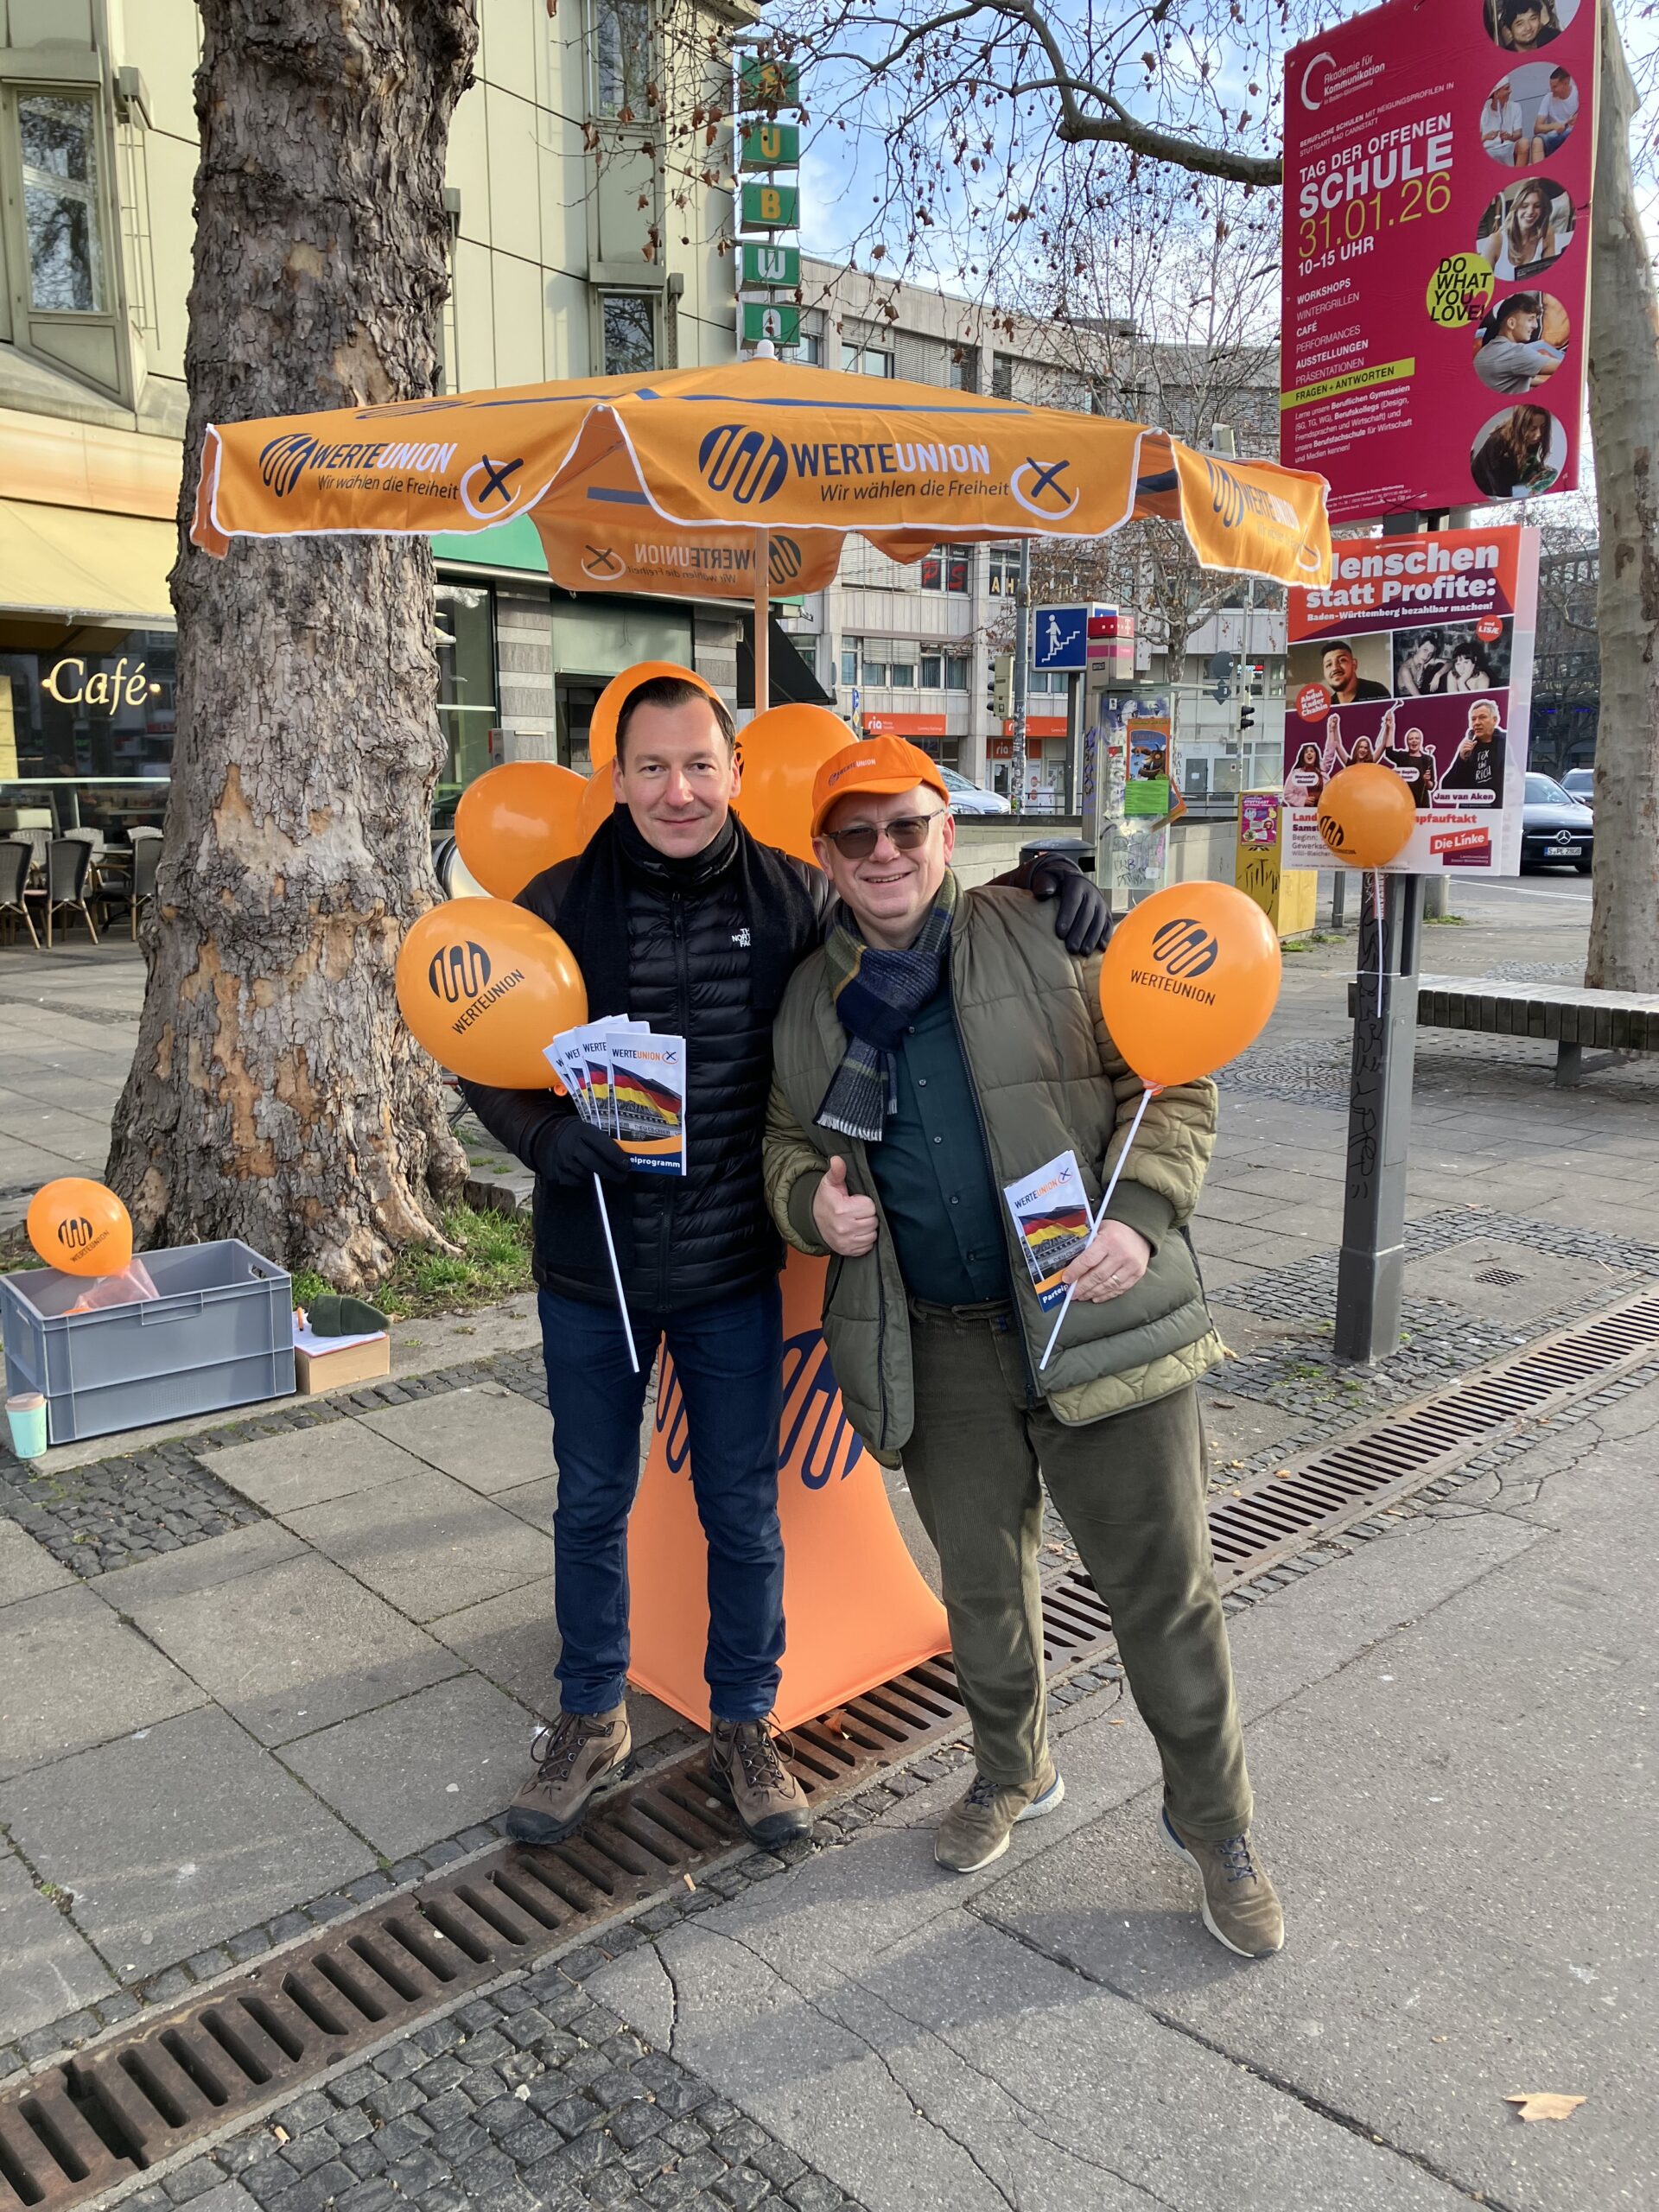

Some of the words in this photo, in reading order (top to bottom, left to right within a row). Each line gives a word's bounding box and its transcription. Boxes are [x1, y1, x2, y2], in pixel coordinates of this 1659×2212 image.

[1324, 60, 1360, 85] Akademie
[1362, 54, 1374, 67] für
[1324, 62, 1385, 97] Kommunikation
[1300, 127, 1334, 148] BERUFLICHE
[1336, 115, 1363, 131] SCHULEN
[1365, 109, 1376, 119] MIT
[1377, 86, 1444, 113] NEIGUNGSPROFILEN
[1446, 82, 1454, 91] IN
[1300, 138, 1331, 157] STUTTGART
[1332, 133, 1344, 143] BAD
[1344, 118, 1378, 137] CANNSTATT
[1300, 156, 1326, 183] TAG
[1332, 143, 1362, 168] DER
[1368, 112, 1452, 155] OFFENEN
[1300, 132, 1453, 219] SCHULE
[1300, 172, 1451, 259] 31.01.26
[1340, 236, 1375, 261] UHR
[1439, 257, 1467, 275] DO
[1297, 277, 1351, 305] WORKSHOPS
[1436, 272, 1492, 289] WHAT
[1296, 291, 1360, 321] WINTERGRILLEN
[1434, 289, 1474, 306] YOU
[1430, 304, 1485, 322] LOVE!
[1296, 321, 1318, 337] CAFÉ
[1296, 324, 1361, 353] PERFORMANCES
[1296, 340, 1369, 370] AUSSTELLUNGEN
[1296, 357, 1364, 385] PRÄSENTATIONEN
[1296, 384, 1327, 401] FRAGEN
[1335, 365, 1395, 390] ANTWORTEN
[1295, 410, 1311, 421] Lerne
[1312, 405, 1331, 416] unsere
[1331, 395, 1368, 410] Beruflichen
[1370, 385, 1410, 402] Gymnasien
[1334, 403, 1379, 421] Berufskollegs
[1295, 425, 1338, 442] Fremdsprachen
[1338, 420, 1350, 430] und
[1388, 410, 1402, 419] und
[1295, 442, 1313, 453] unsere
[1313, 429, 1366, 448] Berufsfachschule
[1367, 426, 1376, 435] für
[1377, 418, 1413, 432] Wirtschaft
[309, 442, 458, 473] WERTEUNION
[791, 442, 990, 478] WERTEUNION
[1295, 454, 1305, 463] und
[1306, 448, 1326, 460] Medien
[318, 474, 335, 491] Wir
[337, 474, 379, 491] wählen
[383, 475, 404, 493] die
[406, 477, 459, 501] Freiheit
[819, 483, 850, 502] Wir
[854, 480, 916, 500] wählen
[919, 480, 944, 497] die
[948, 480, 1009, 498] Freiheit
[1306, 587, 1375, 607] statt
[1382, 574, 1496, 604] Profite:
[1307, 607, 1400, 621] Baden-Württemberg
[1402, 604, 1448, 615] bezahlbar
[1451, 601, 1493, 612] machen!
[49, 658, 148, 715] Café
[868, 715, 882, 729] ria
[996, 741, 1009, 754] ria
[1292, 833, 1319, 842] Beginn:
[1434, 838, 1453, 849] Die
[1454, 833, 1485, 847] Linke
[731, 933, 751, 943] NORT
[452, 969, 525, 1035] WERTEUNION
[1130, 969, 1216, 1007] WERTEUNION
[582, 1042, 607, 1052] WERTE
[612, 1049, 660, 1061] WERTEUNION
[630, 1156, 680, 1168] eiprogramm
[1014, 1179, 1058, 1210] WERTEUNION
[70, 1230, 110, 1262] WERTEUNION
[1042, 1284, 1069, 1304] Parteip
